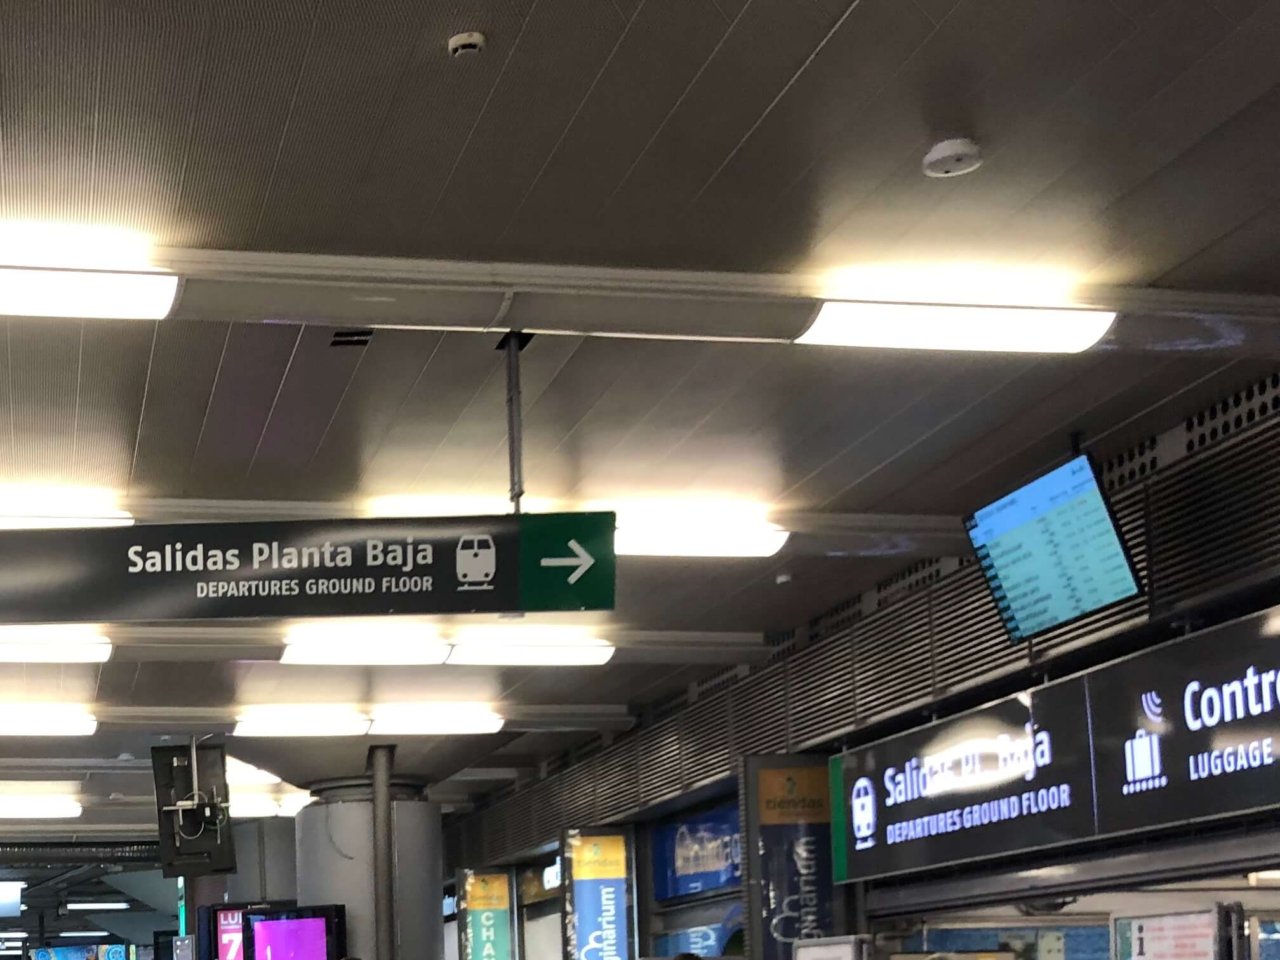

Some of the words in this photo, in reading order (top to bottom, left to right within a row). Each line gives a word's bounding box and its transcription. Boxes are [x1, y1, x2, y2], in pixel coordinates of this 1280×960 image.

[128, 543, 240, 573] Salidas
[252, 541, 352, 570] Planta
[366, 537, 433, 571] Baja
[196, 580, 299, 598] DEPARTURES
[306, 578, 375, 595] GROUND
[382, 576, 433, 593] FLOOR
[1184, 665, 1280, 731] Contr
[1189, 737, 1273, 781] LUGGAGE
[886, 809, 962, 844] DEPARTURES
[963, 795, 1020, 829] GROUND
[1022, 783, 1070, 815] FLOOR
